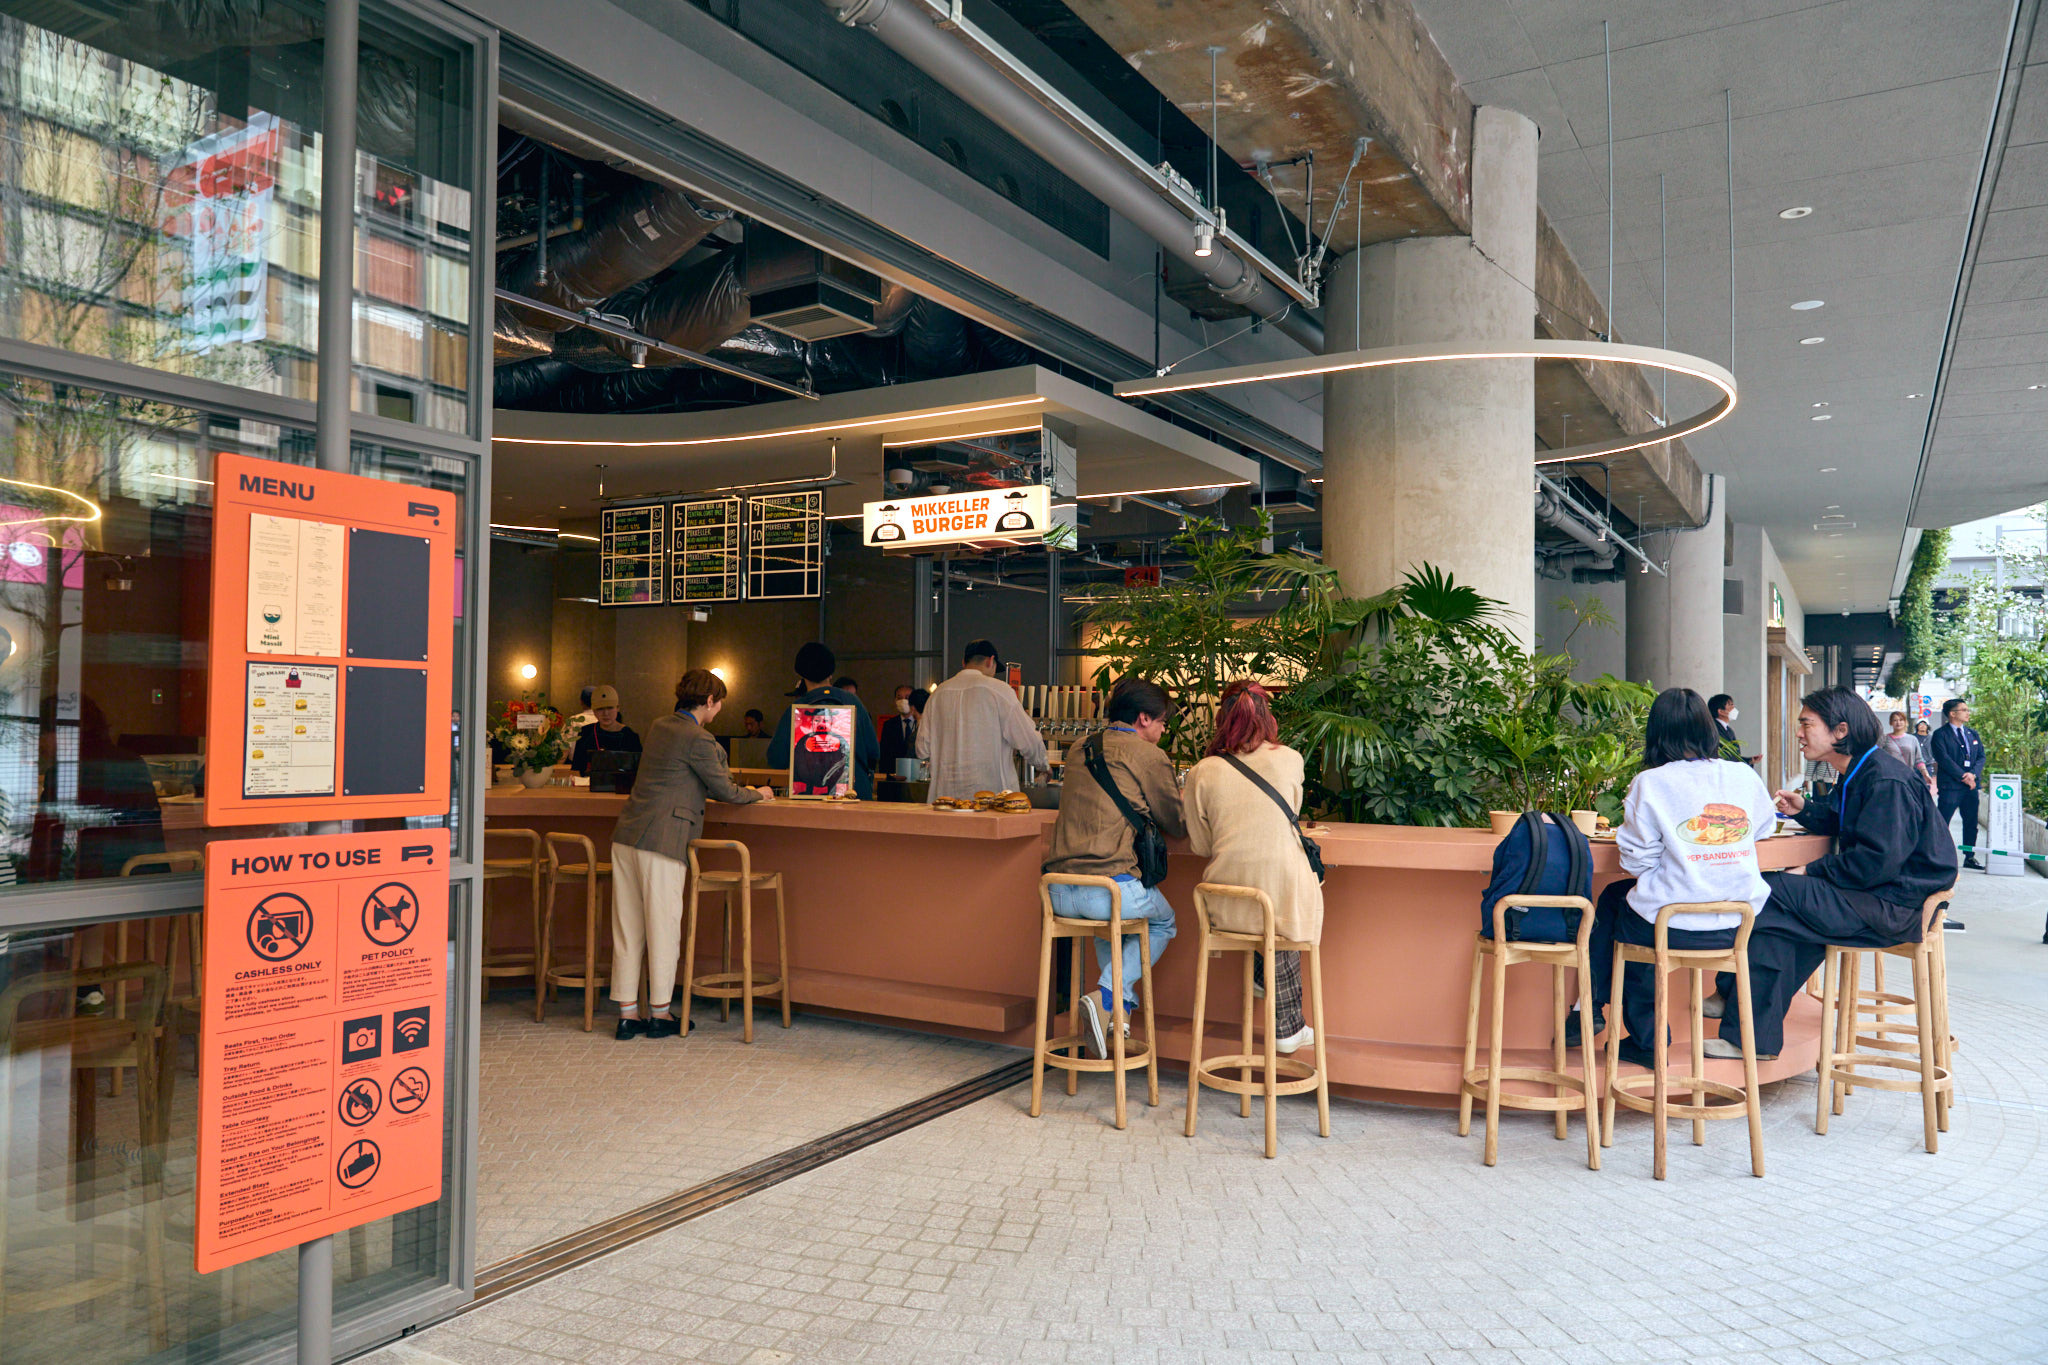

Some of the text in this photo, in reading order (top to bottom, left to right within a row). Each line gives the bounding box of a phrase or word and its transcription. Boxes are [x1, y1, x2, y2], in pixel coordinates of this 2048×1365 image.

[240, 474, 314, 501] MENU
[911, 498, 990, 517] MIKKELLER
[606, 516, 611, 528] 1
[676, 510, 682, 525] 5
[912, 514, 988, 534] BURGER
[676, 532, 682, 548] 6
[752, 529, 762, 542] 10
[605, 540, 611, 552] 2
[604, 562, 611, 576] 3
[676, 558, 682, 572] 7
[676, 582, 682, 598] 8
[231, 854, 294, 876] HOW
[298, 852, 330, 870] TO
[336, 848, 381, 868] USE
[362, 948, 414, 962] PET POLICY
[234, 960, 322, 980] CASHLESS ONLY
